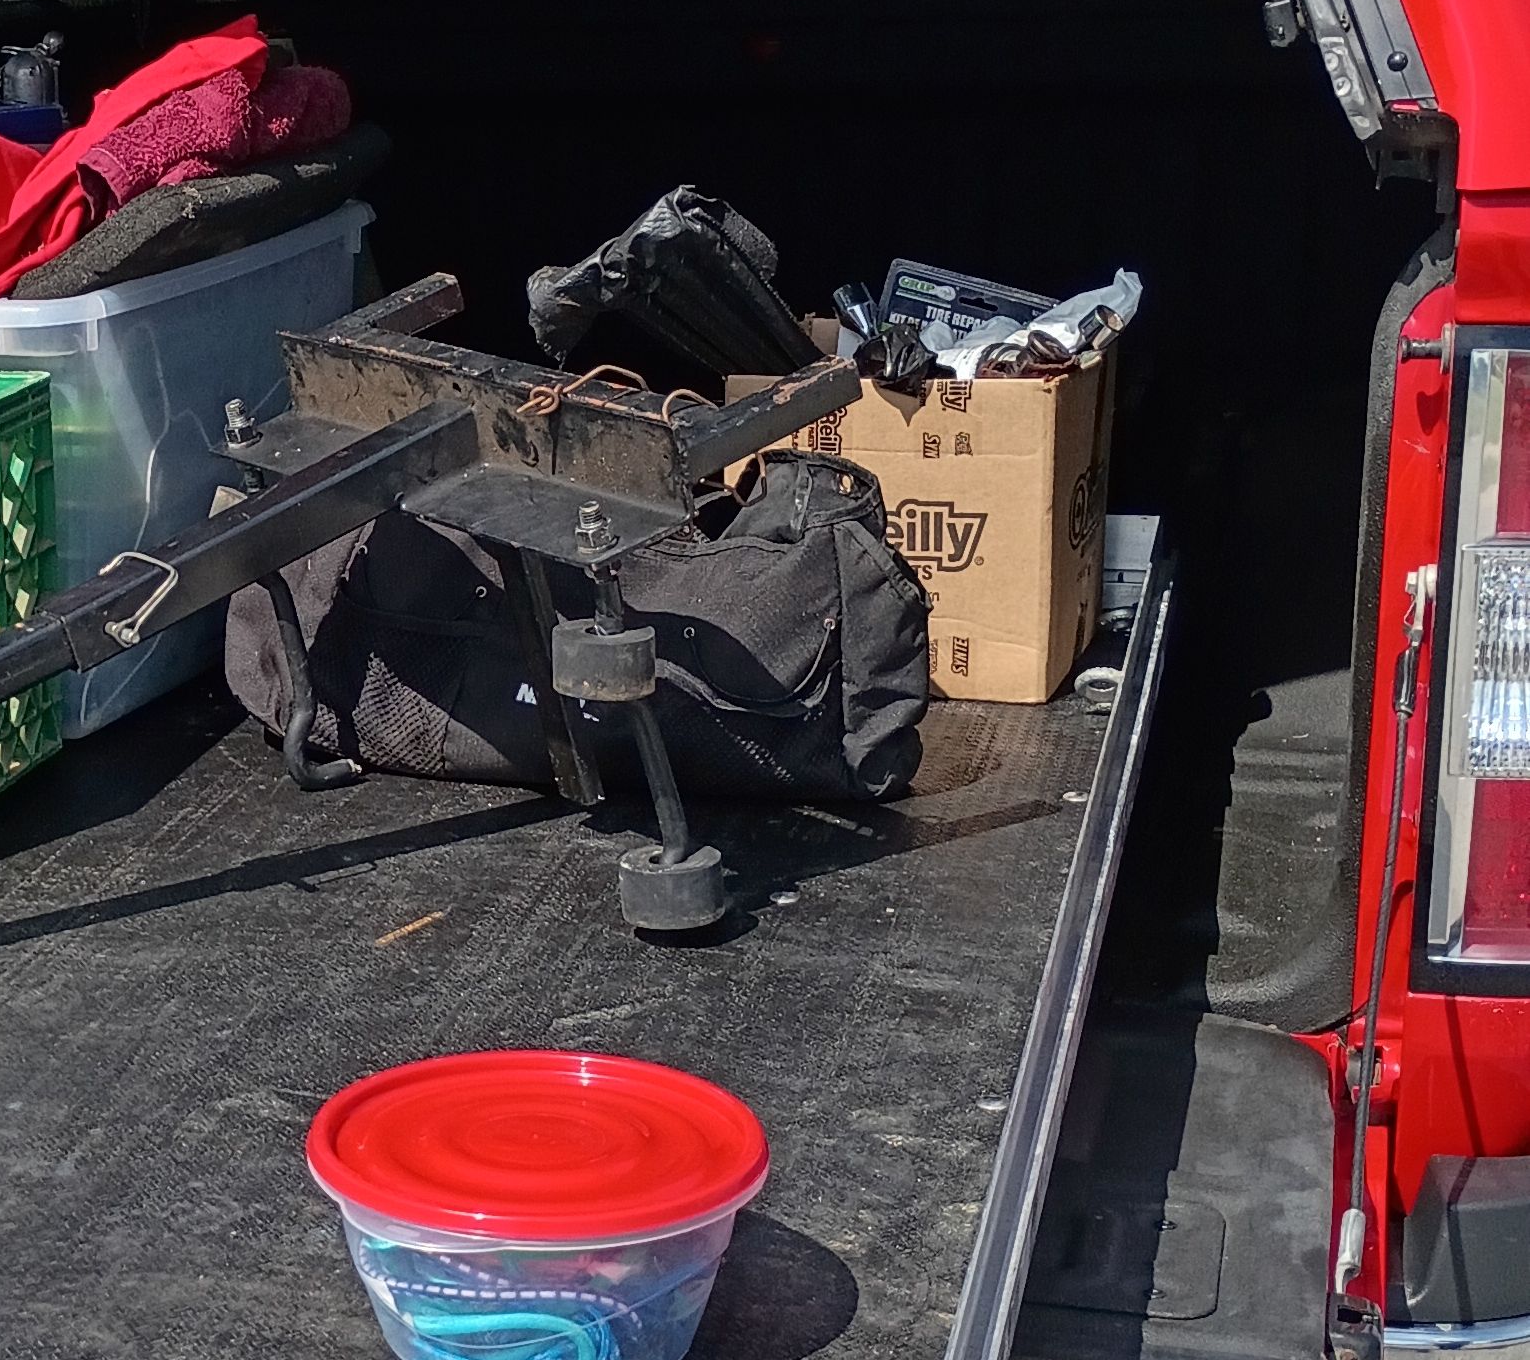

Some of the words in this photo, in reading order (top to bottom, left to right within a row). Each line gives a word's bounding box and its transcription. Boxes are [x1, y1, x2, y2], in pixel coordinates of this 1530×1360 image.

[889, 311, 907, 325] KIT
[926, 305, 951, 324] TIRE
[952, 312, 987, 330] REPA
[951, 636, 969, 677] SYNTE
